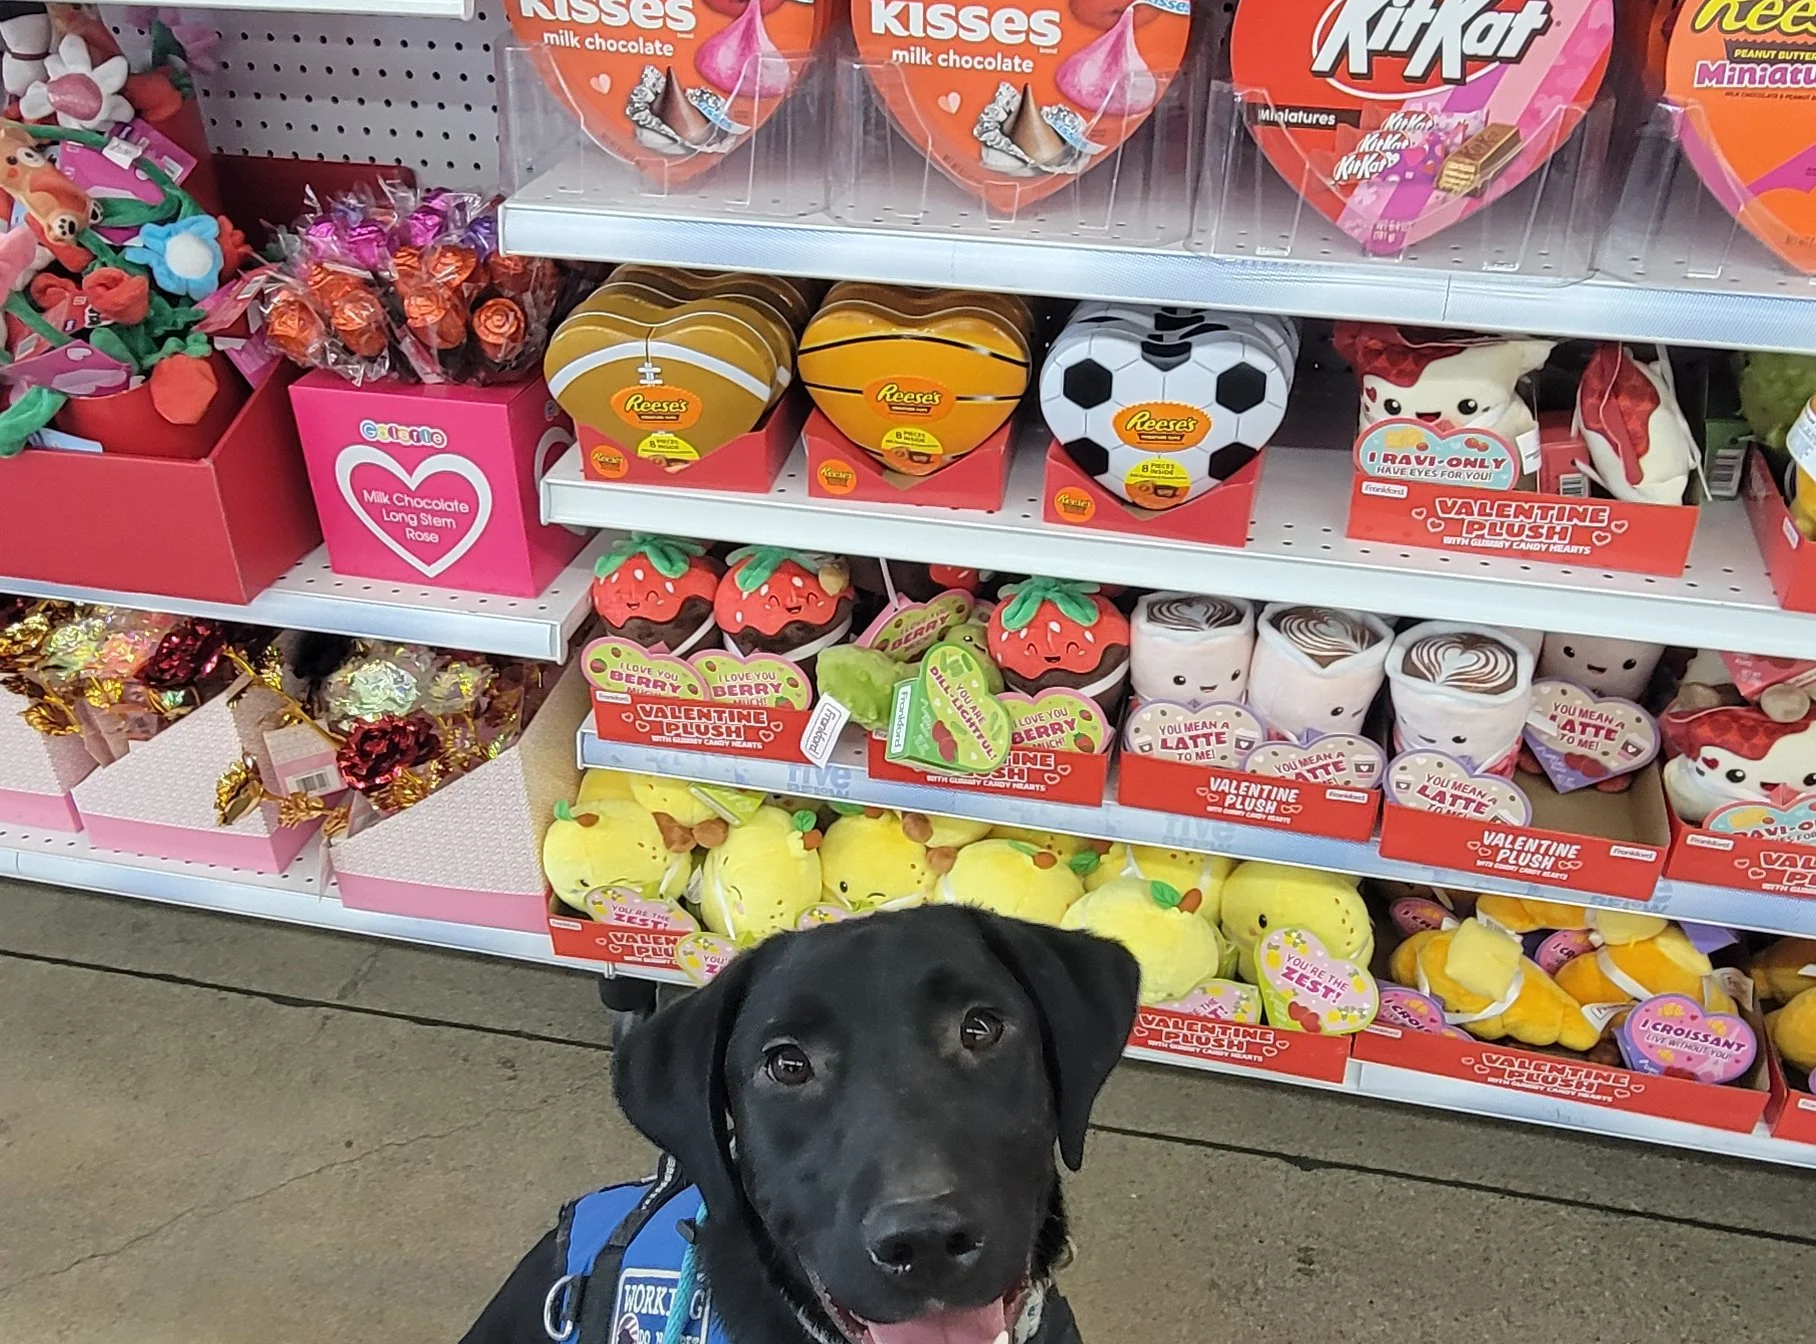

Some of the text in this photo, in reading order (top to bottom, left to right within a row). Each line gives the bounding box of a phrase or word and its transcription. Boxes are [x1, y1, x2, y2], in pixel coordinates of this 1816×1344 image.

[543, 30, 674, 57] milk chocolate
[892, 47, 1034, 73] milk chocolate
[1735, 49, 1776, 60] PEANUT
[1258, 110, 1336, 127] Miniatures
[625, 394, 687, 412] Reese's
[877, 384, 942, 405] Reese's
[1125, 410, 1199, 433] Reese's
[360, 420, 447, 449] Galerie
[1368, 451, 1378, 464] I
[1141, 464, 1149, 473] 8
[1376, 467, 1493, 482] HAVE EYES FOR YOU!
[363, 489, 469, 513] Milk Chocolate
[382, 508, 456, 529] Long Stem
[1435, 498, 1610, 527] VALENTINE
[406, 528, 439, 544] Rose
[1462, 519, 1574, 544] PLUSH
[1443, 536, 1591, 555] WITH GUMMY CANDY HEARTS
[609, 670, 682, 695] BERRY
[627, 663, 653, 675] LOVE
[657, 668, 679, 682] YOU
[724, 673, 751, 682] LOVE
[755, 671, 777, 681] YOU
[712, 682, 783, 698] BERRY
[636, 704, 767, 725] VALENTINE
[955, 683, 986, 725] YOU ARE
[1018, 713, 1045, 727] LOVE
[1047, 708, 1068, 719] YOU
[1553, 703, 1625, 730] YOU MEAN A
[663, 721, 745, 740] PLUSH
[1012, 718, 1076, 744] BERRY
[1159, 721, 1229, 735] YOU MEAN A
[1160, 732, 1228, 751] LATTE
[1559, 733, 1599, 751] TO ME!
[1177, 751, 1215, 761] TO ME!
[1275, 763, 1297, 773] YOU
[1300, 753, 1332, 767] MEAN
[1210, 777, 1300, 803] VALENTINE
[1425, 773, 1498, 805] YOU MEAN A
[1224, 794, 1277, 814] PLUSH
[1416, 784, 1489, 816] LATTE
[1482, 830, 1581, 859] VALENTINE
[1496, 848, 1554, 870] PLUSH
[612, 905, 670, 922] YOU'RE THE
[1286, 954, 1349, 991] YOU'RE THE
[1281, 966, 1342, 1004] ZEST!
[1138, 1013, 1275, 1042] VALENTINE
[1641, 1019, 1746, 1052] I CROISSANT
[1163, 1031, 1248, 1053] PLUSH
[1646, 1034, 1665, 1044] LIVE
[1668, 1038, 1707, 1054] WITHOUT
[1482, 1053, 1630, 1087] VALENTINE
[1505, 1070, 1597, 1094] PLUSH
[624, 1284, 706, 1320] WORKIG
